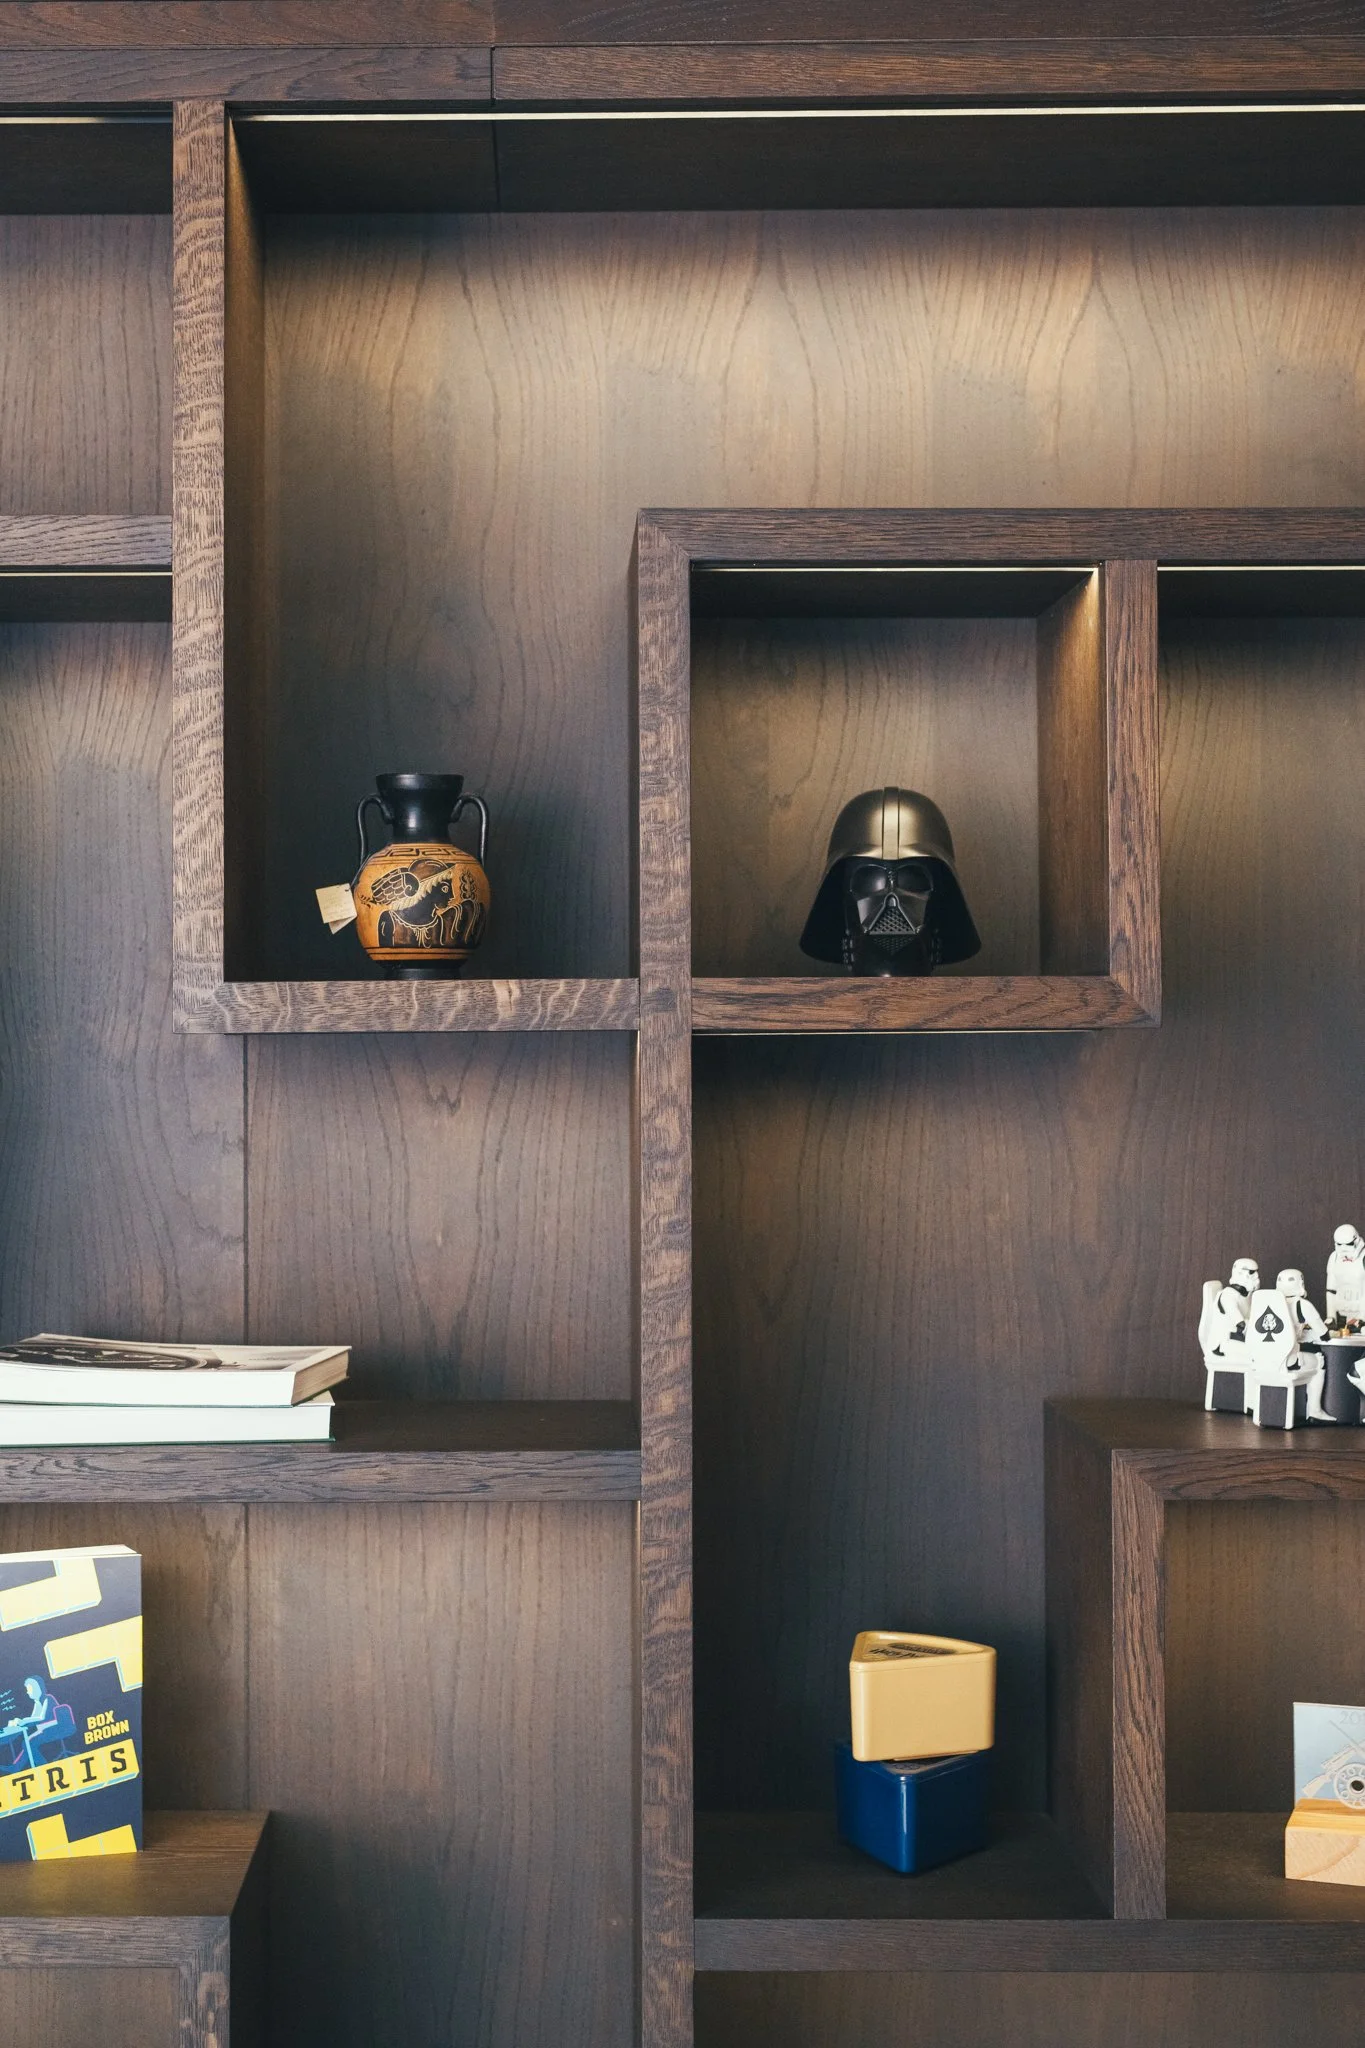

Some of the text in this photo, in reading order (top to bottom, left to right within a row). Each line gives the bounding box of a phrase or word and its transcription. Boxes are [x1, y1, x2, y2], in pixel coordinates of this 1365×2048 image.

[84, 1720, 130, 1745] BROWN
[87, 1710, 115, 1730] BOX
[0, 1748, 127, 1808] TRIS
